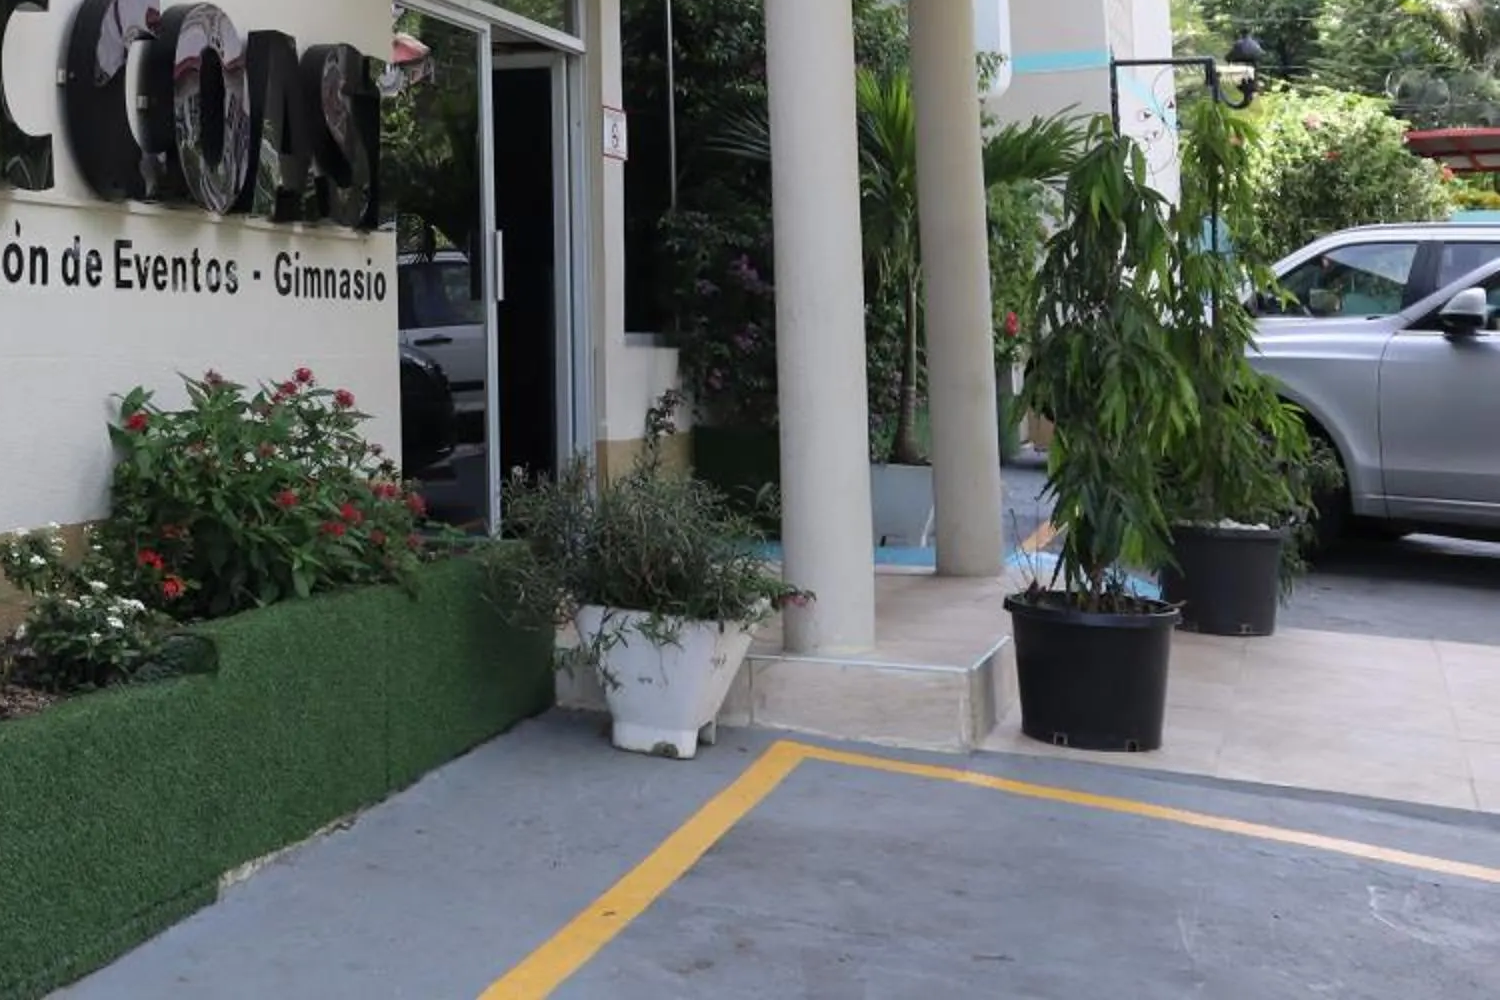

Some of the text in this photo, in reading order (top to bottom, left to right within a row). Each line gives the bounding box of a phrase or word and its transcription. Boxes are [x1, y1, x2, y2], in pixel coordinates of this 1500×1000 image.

[61, 234, 103, 288] de
[113, 238, 239, 295] Eventos
[273, 250, 387, 302] Gimnasio
